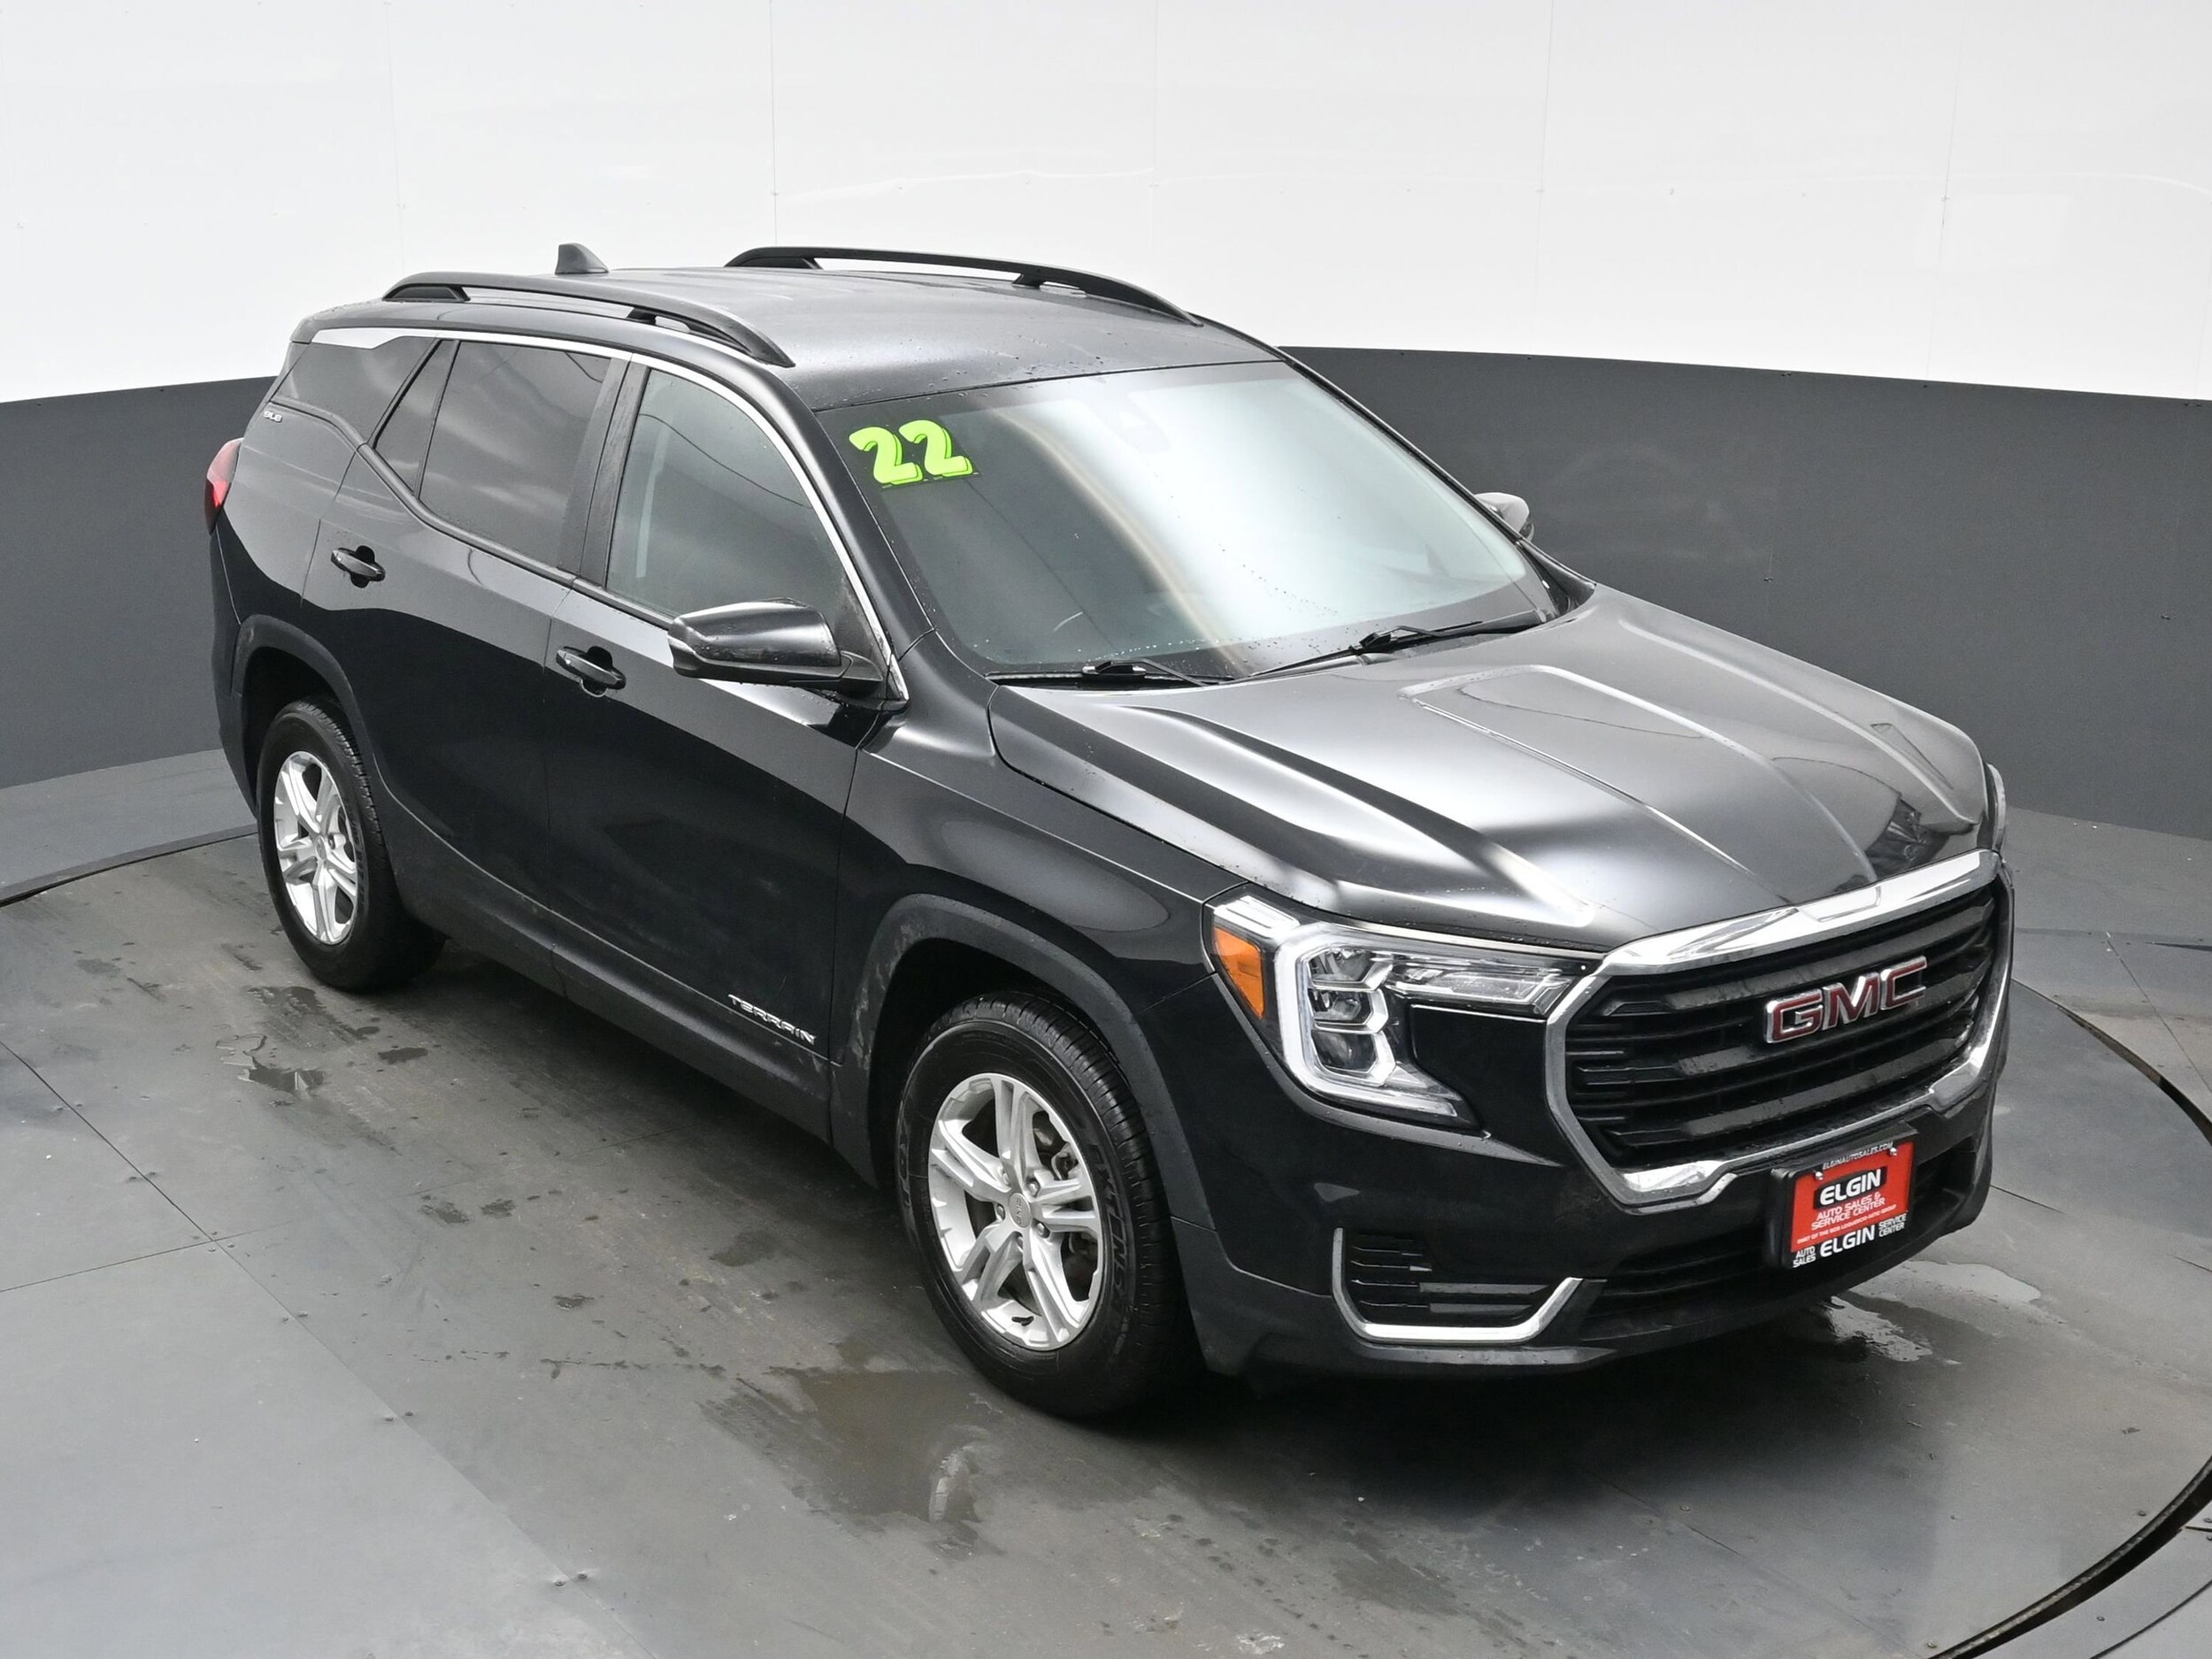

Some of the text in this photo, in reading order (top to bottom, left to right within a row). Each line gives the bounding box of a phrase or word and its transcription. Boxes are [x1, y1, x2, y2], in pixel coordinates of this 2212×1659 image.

[849, 419, 973, 486] 22
[1765, 956, 1927, 1043] GMC
[728, 994, 816, 1045] TERRAIN
[1820, 1169, 1881, 1206] ELGIN
[1811, 1197, 1886, 1230] SERVICE CENTER
[1816, 1206, 1842, 1221] AUTO
[1845, 1194, 1872, 1212] SALES
[1878, 1213, 1907, 1230] SERVICE
[1820, 1225, 1875, 1257] ELGIN
[1878, 1222, 1905, 1237] CENTER
[1793, 1253, 1816, 1268] SALES
[1795, 1246, 1816, 1258] AUTO
